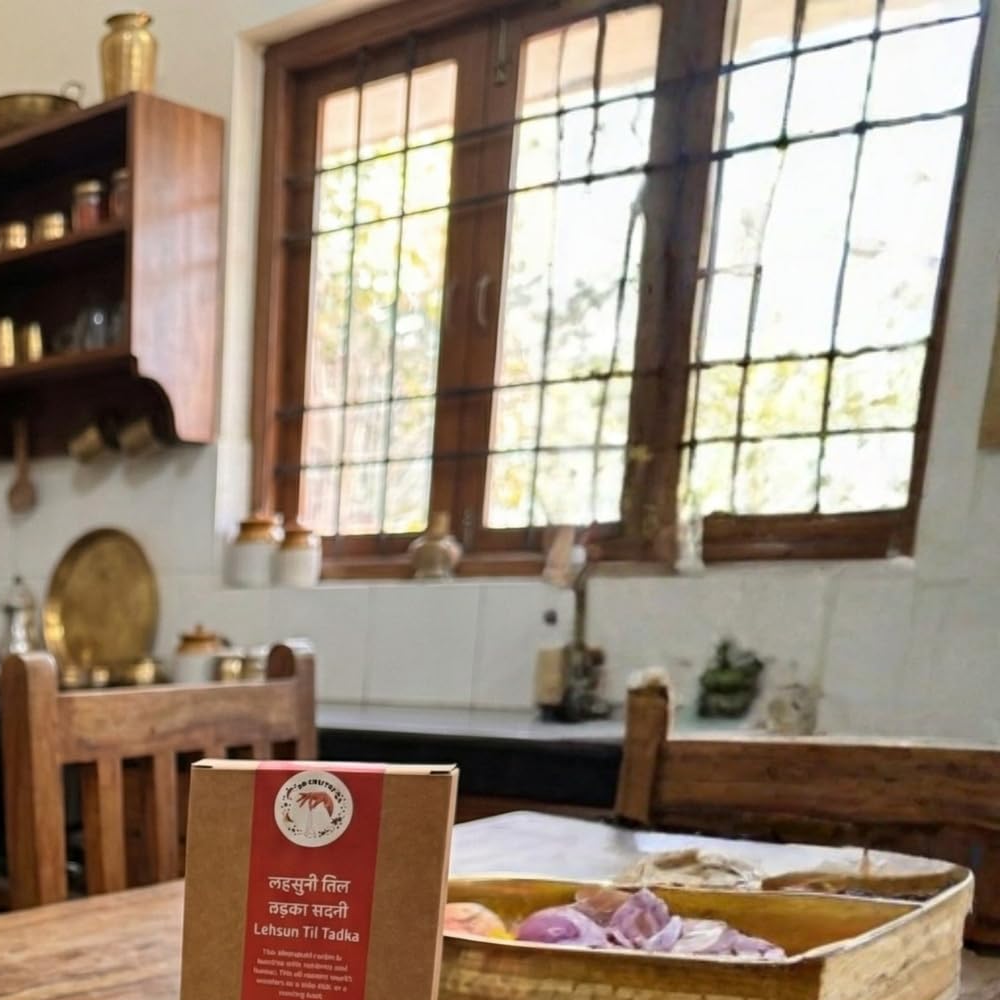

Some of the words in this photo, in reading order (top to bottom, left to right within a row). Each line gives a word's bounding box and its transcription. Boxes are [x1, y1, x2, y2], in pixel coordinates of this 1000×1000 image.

[268, 873, 318, 896] लहसुनी
[321, 874, 351, 894] तिल
[254, 922, 299, 938] Lehsun
[302, 925, 318, 940] Til
[322, 927, 360, 943] Tadka
